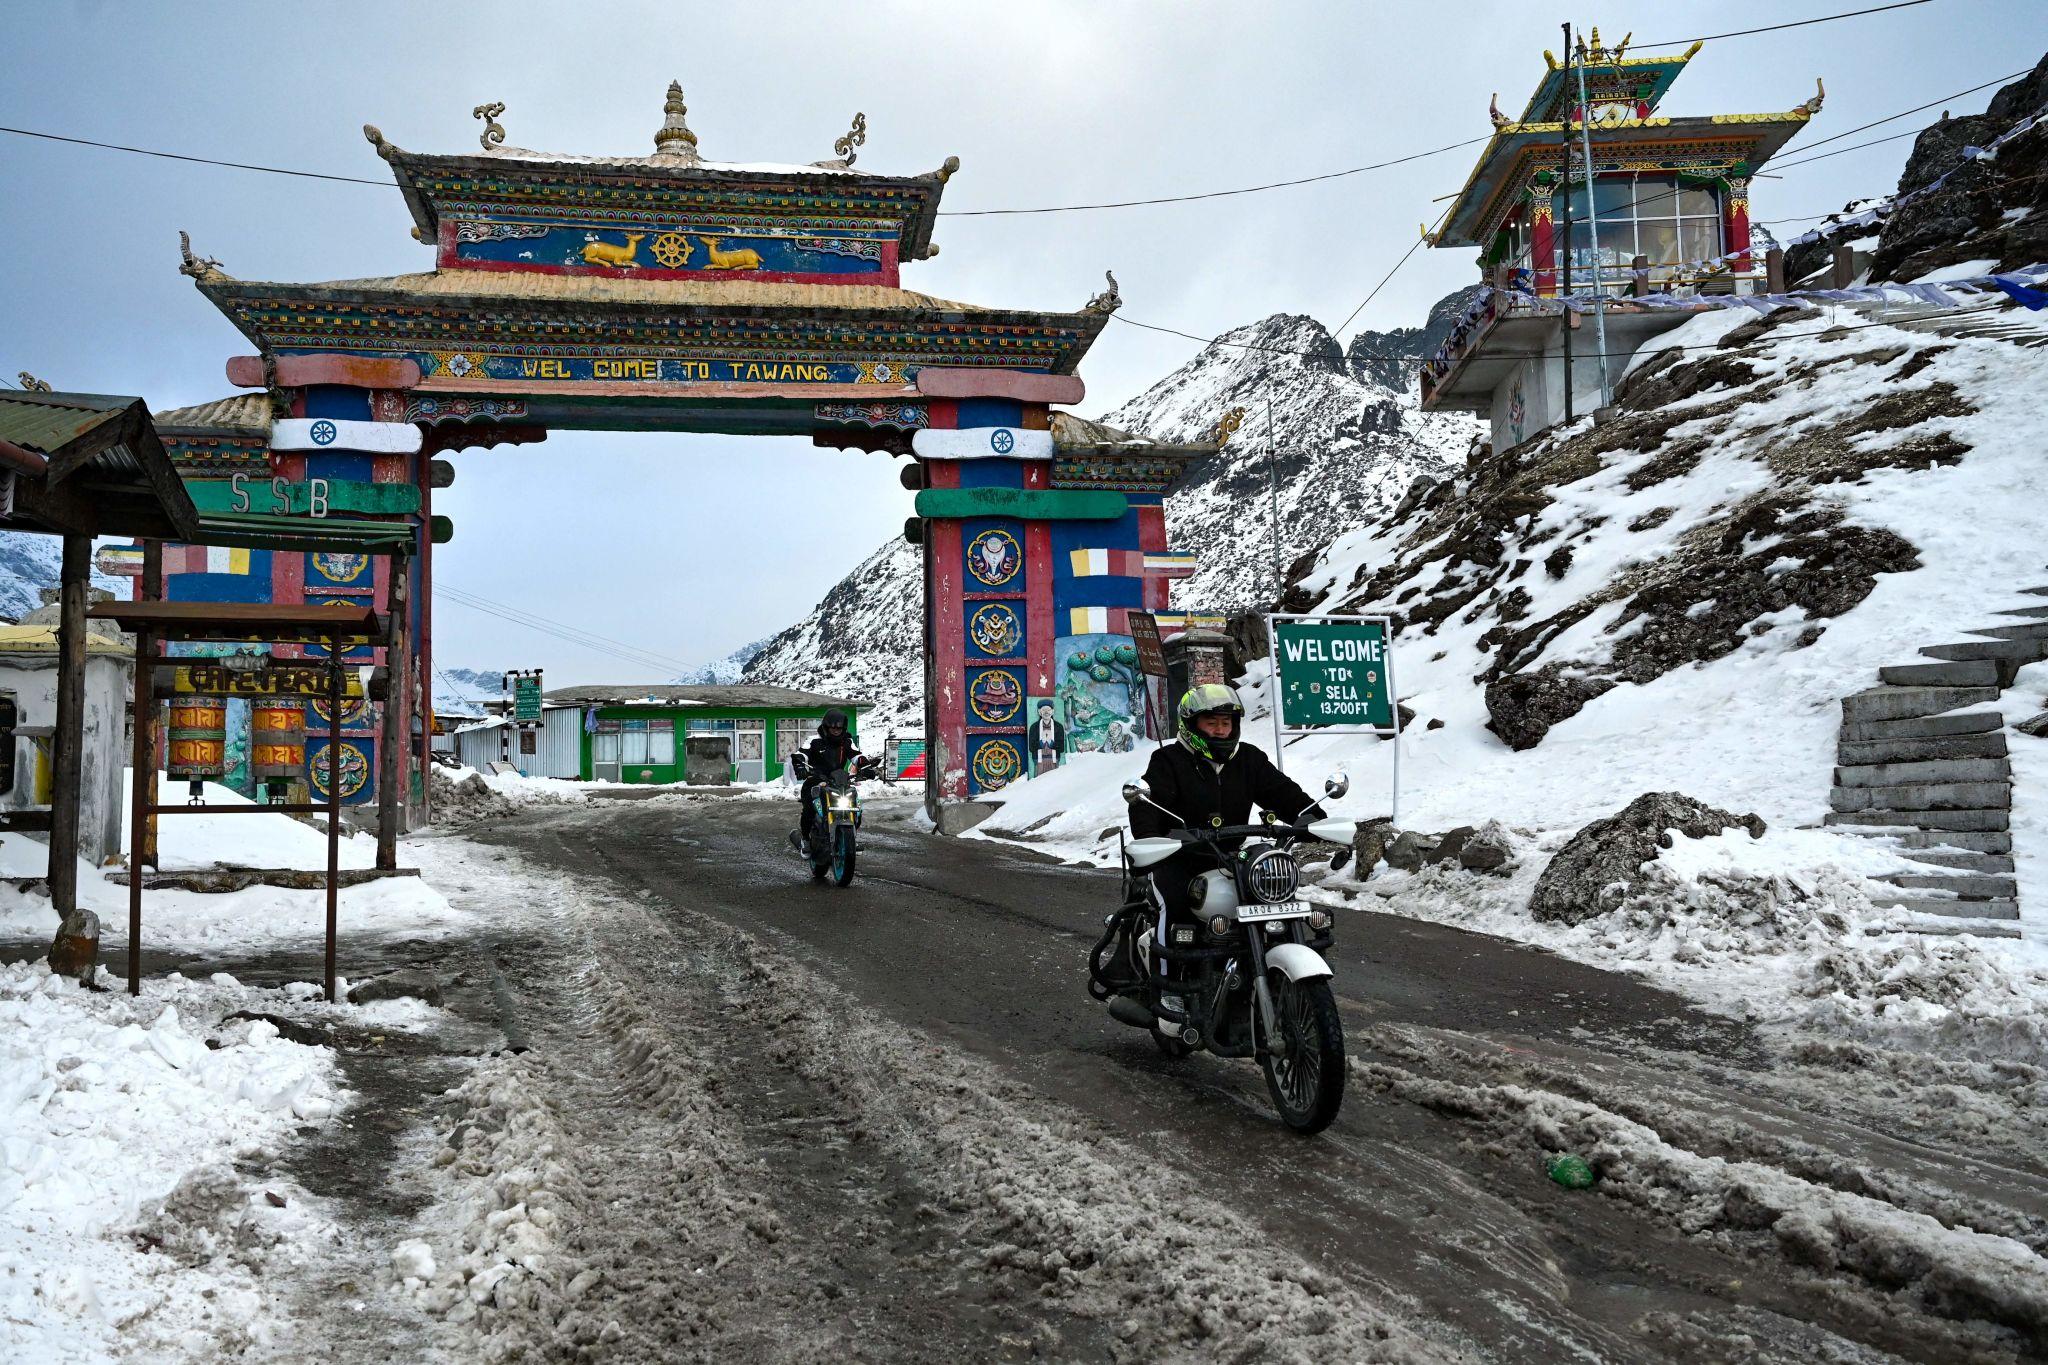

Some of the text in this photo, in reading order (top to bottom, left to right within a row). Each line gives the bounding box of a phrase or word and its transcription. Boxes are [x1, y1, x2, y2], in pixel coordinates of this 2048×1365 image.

[683, 362, 709, 380] TO
[728, 362, 829, 382] TAWANG
[1328, 667, 1346, 682] TO
[1325, 685, 1358, 700] SELA
